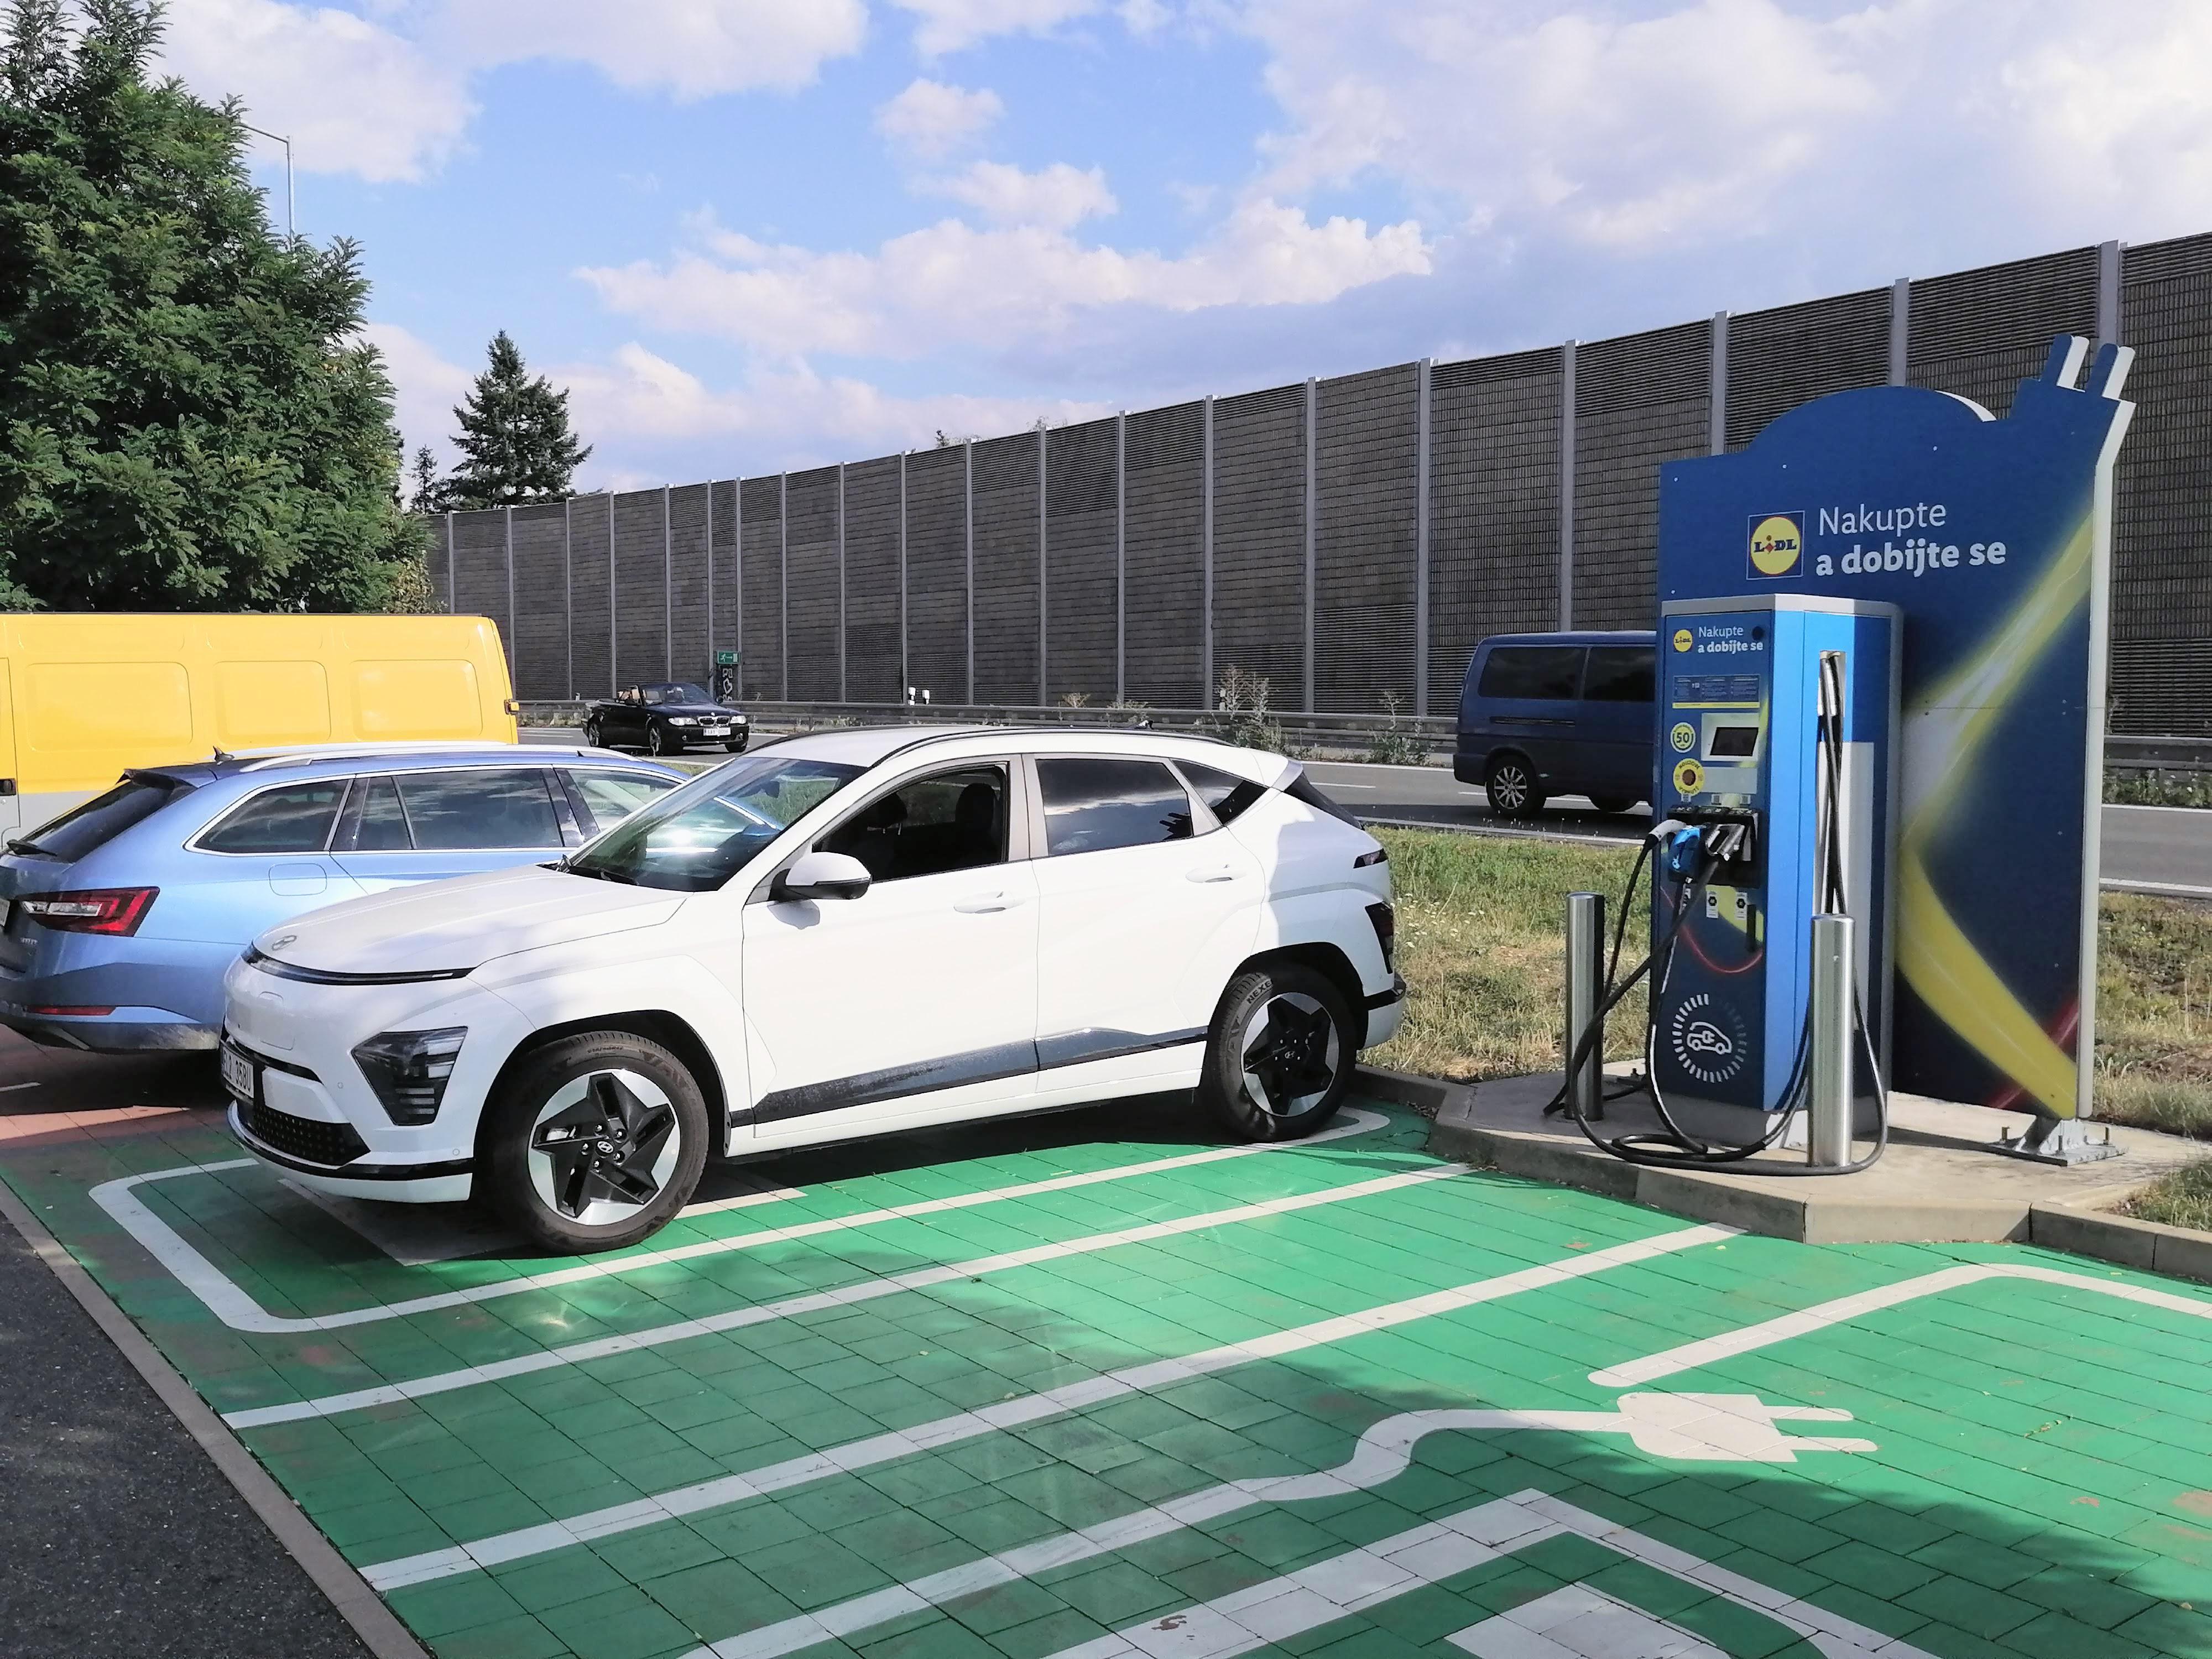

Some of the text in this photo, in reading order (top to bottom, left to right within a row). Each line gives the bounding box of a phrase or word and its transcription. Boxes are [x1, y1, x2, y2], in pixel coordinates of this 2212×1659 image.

[1819, 502, 1947, 537] Nakupte
[1815, 538, 2006, 577] a dobijte se
[1698, 625, 1744, 639] Nakupte
[1698, 639, 1764, 654] a dobijte se
[1676, 733, 1689, 743] 50
